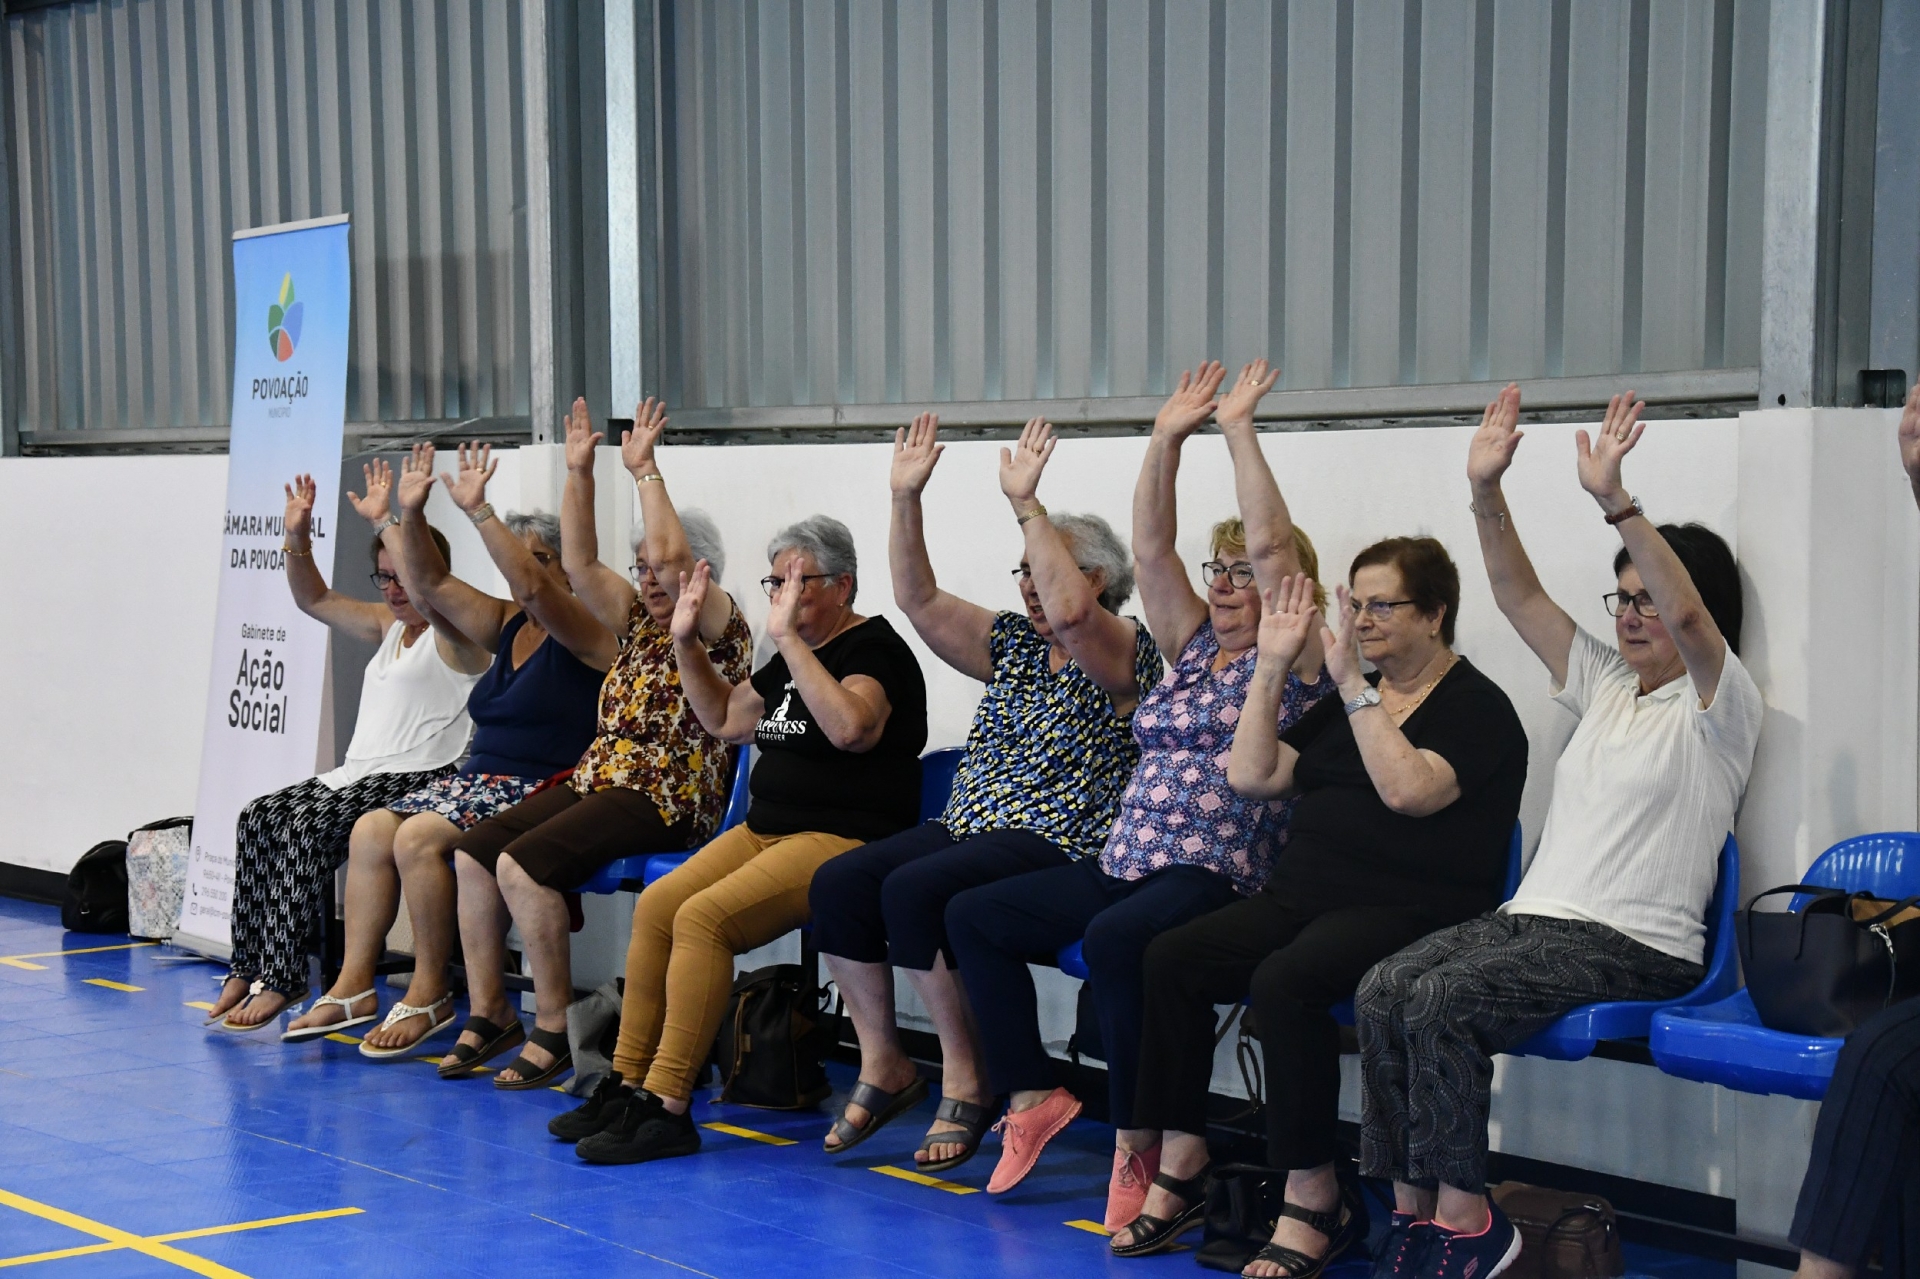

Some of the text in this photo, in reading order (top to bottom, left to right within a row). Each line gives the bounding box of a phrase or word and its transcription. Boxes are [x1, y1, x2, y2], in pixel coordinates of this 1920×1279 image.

[252, 370, 309, 405] POVOAÇÃO
[224, 509, 263, 536] ÂMARA
[230, 548, 285, 570] DA POVOA
[241, 623, 286, 642] Gabinete de
[236, 648, 284, 695] Ação
[228, 689, 287, 734] Social
[755, 718, 807, 735] APPINESS
[758, 732, 786, 742] FOREVER
